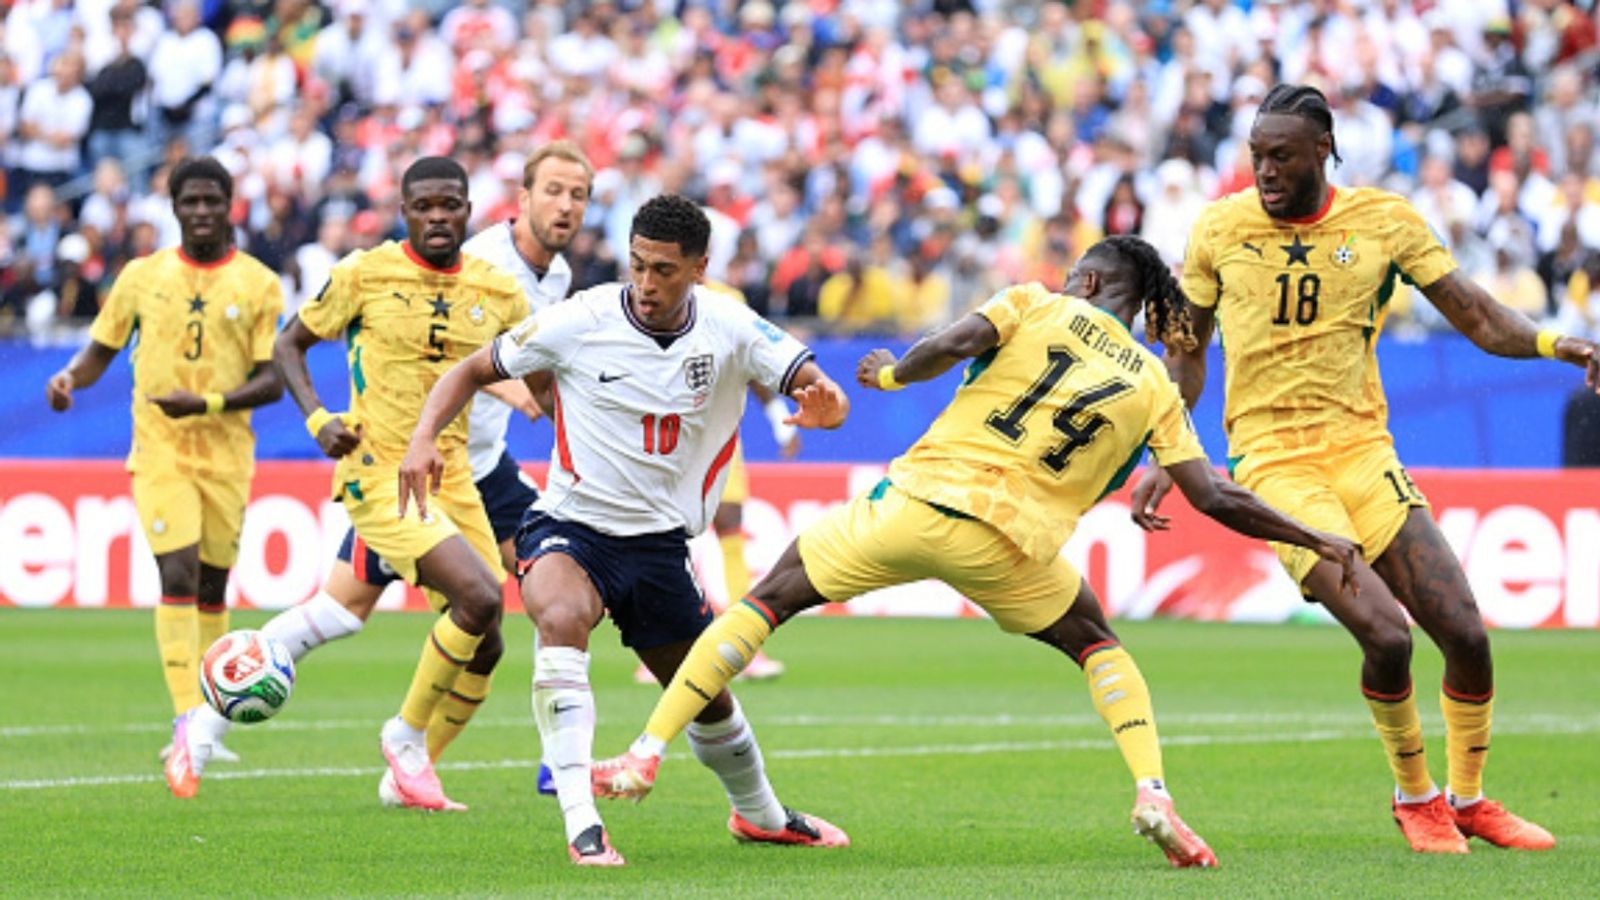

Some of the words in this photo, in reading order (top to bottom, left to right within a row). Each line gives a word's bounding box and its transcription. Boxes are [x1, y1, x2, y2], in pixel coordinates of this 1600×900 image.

[1272, 272, 1321, 326] 18
[184, 320, 203, 361] 3
[429, 323, 447, 363] 5
[640, 412, 681, 455] 10
[984, 344, 1136, 480] 14
